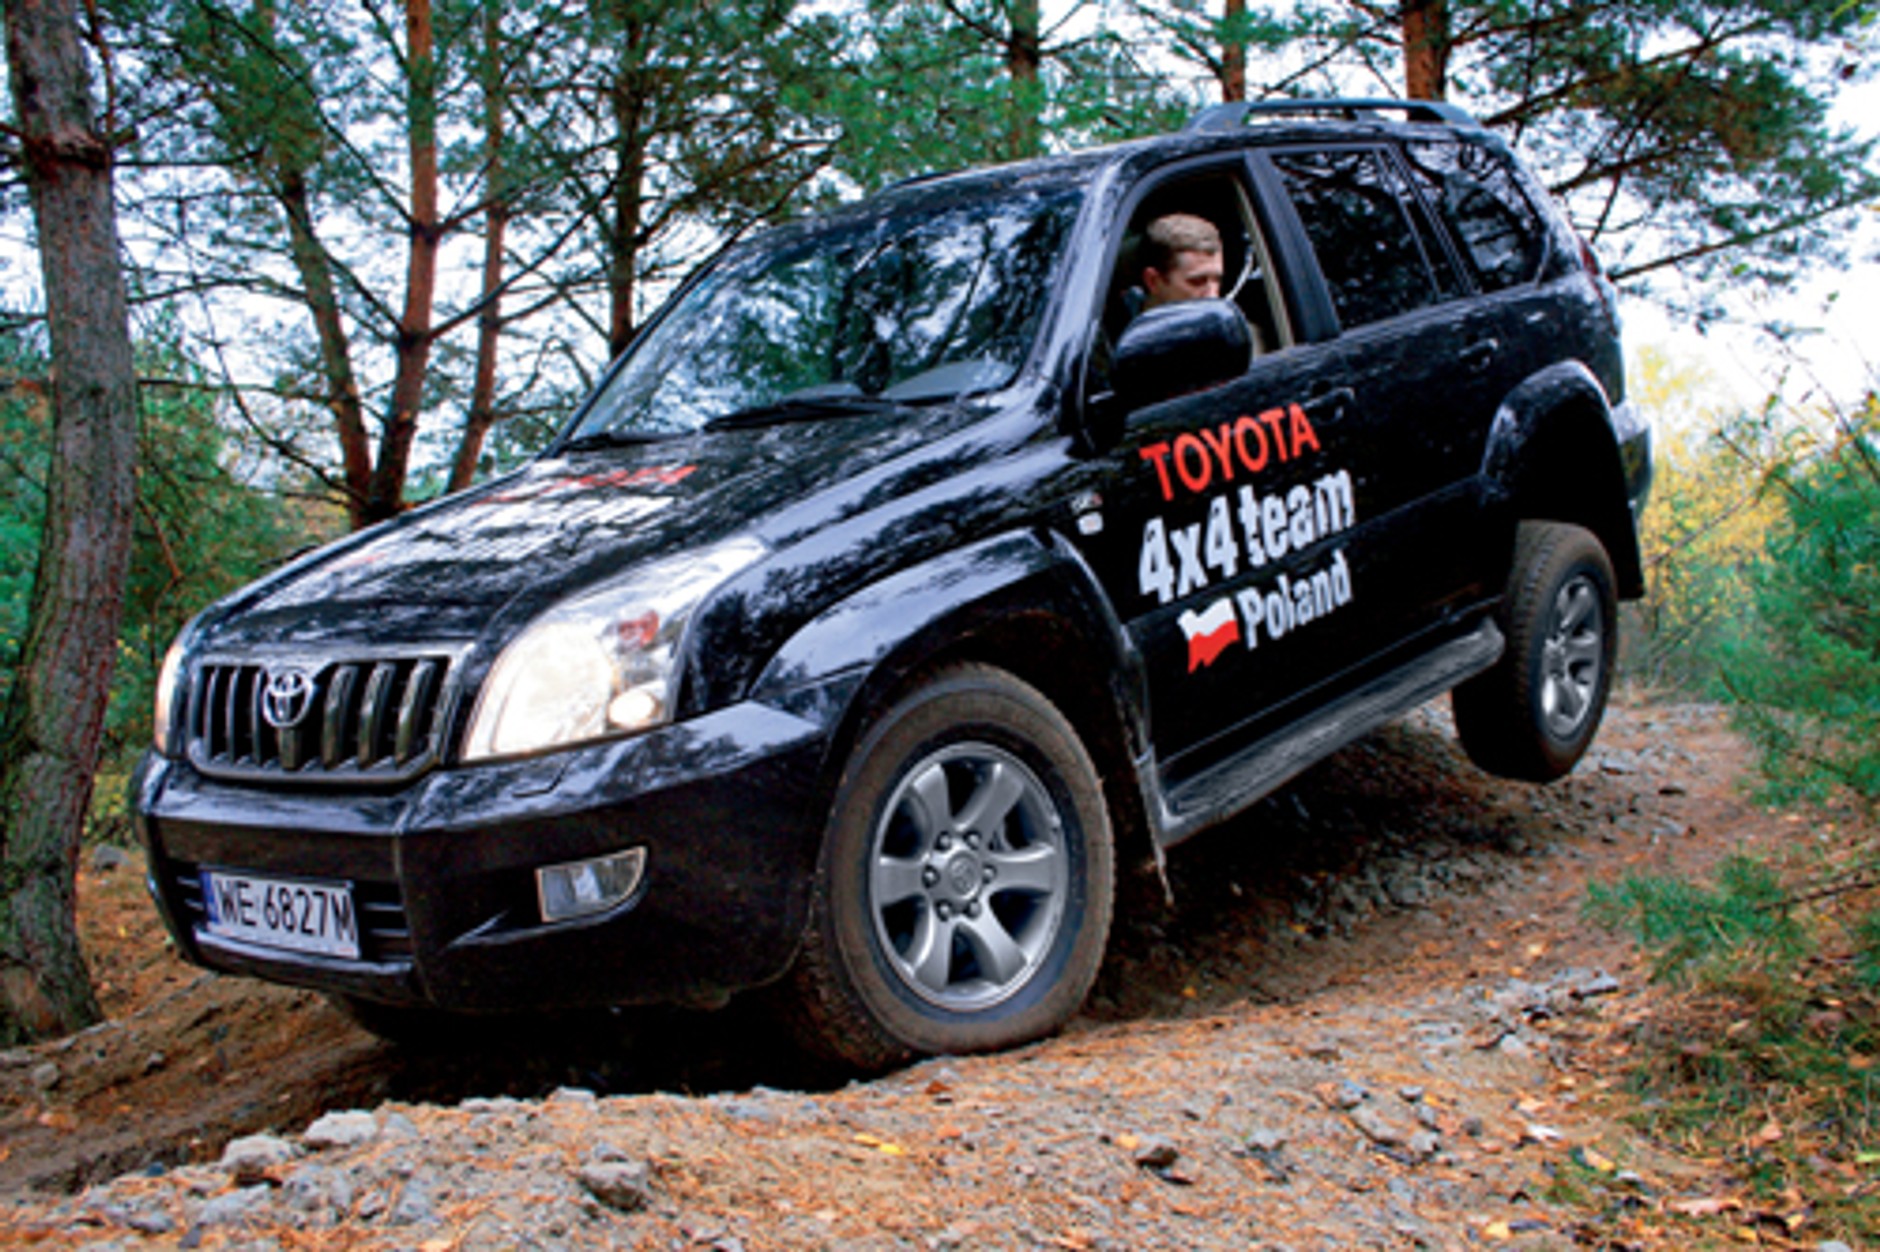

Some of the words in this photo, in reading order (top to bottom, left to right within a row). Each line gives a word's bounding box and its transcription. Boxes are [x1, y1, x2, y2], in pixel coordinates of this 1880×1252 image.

[1139, 402, 1321, 500] TOYOTA
[1138, 495, 1238, 604] 4x4
[1237, 468, 1356, 567] team
[1236, 549, 1353, 651] Poland
